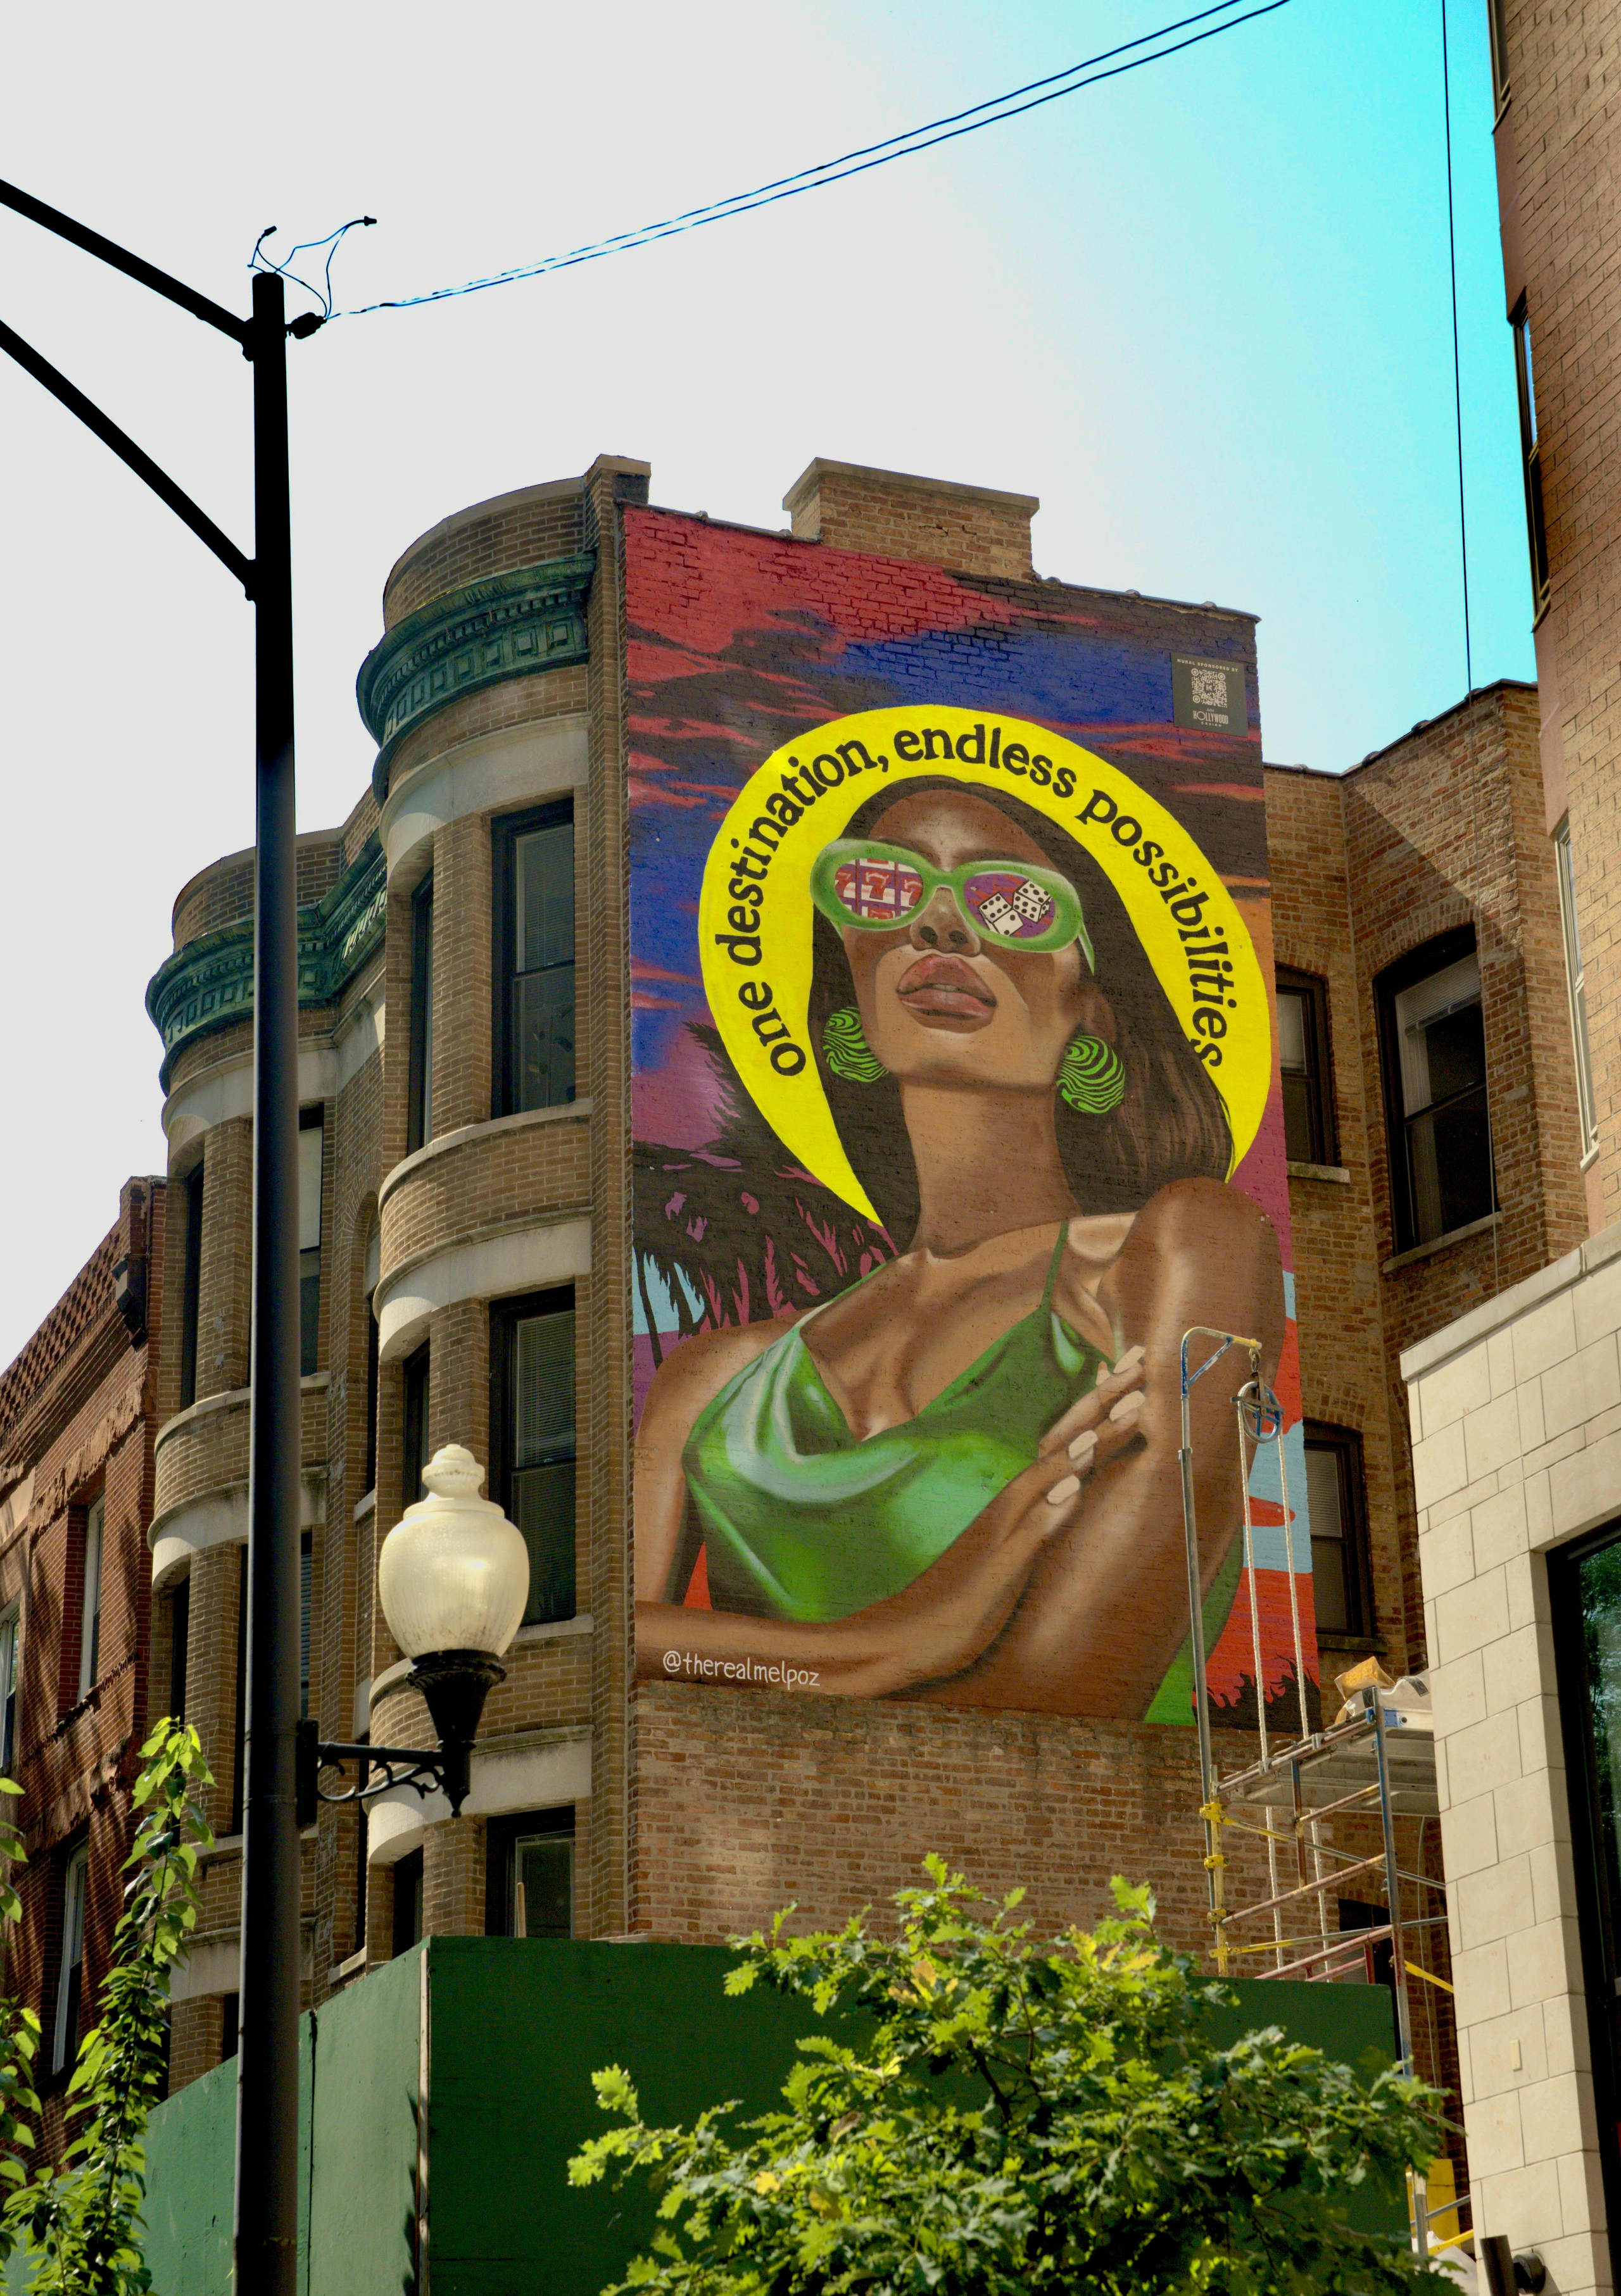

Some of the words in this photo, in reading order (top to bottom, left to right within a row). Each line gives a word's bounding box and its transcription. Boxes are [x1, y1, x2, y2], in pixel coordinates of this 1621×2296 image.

[1197, 662, 1230, 671] SPONSORED
[1193, 710, 1228, 724] HOLLYWOOD
[893, 724, 1077, 798] endless
[714, 739, 889, 967] destination,
[1075, 789, 1238, 1068] possibilities
[738, 981, 807, 1077] one
[663, 1650, 821, 1690] @therealmelpoz
